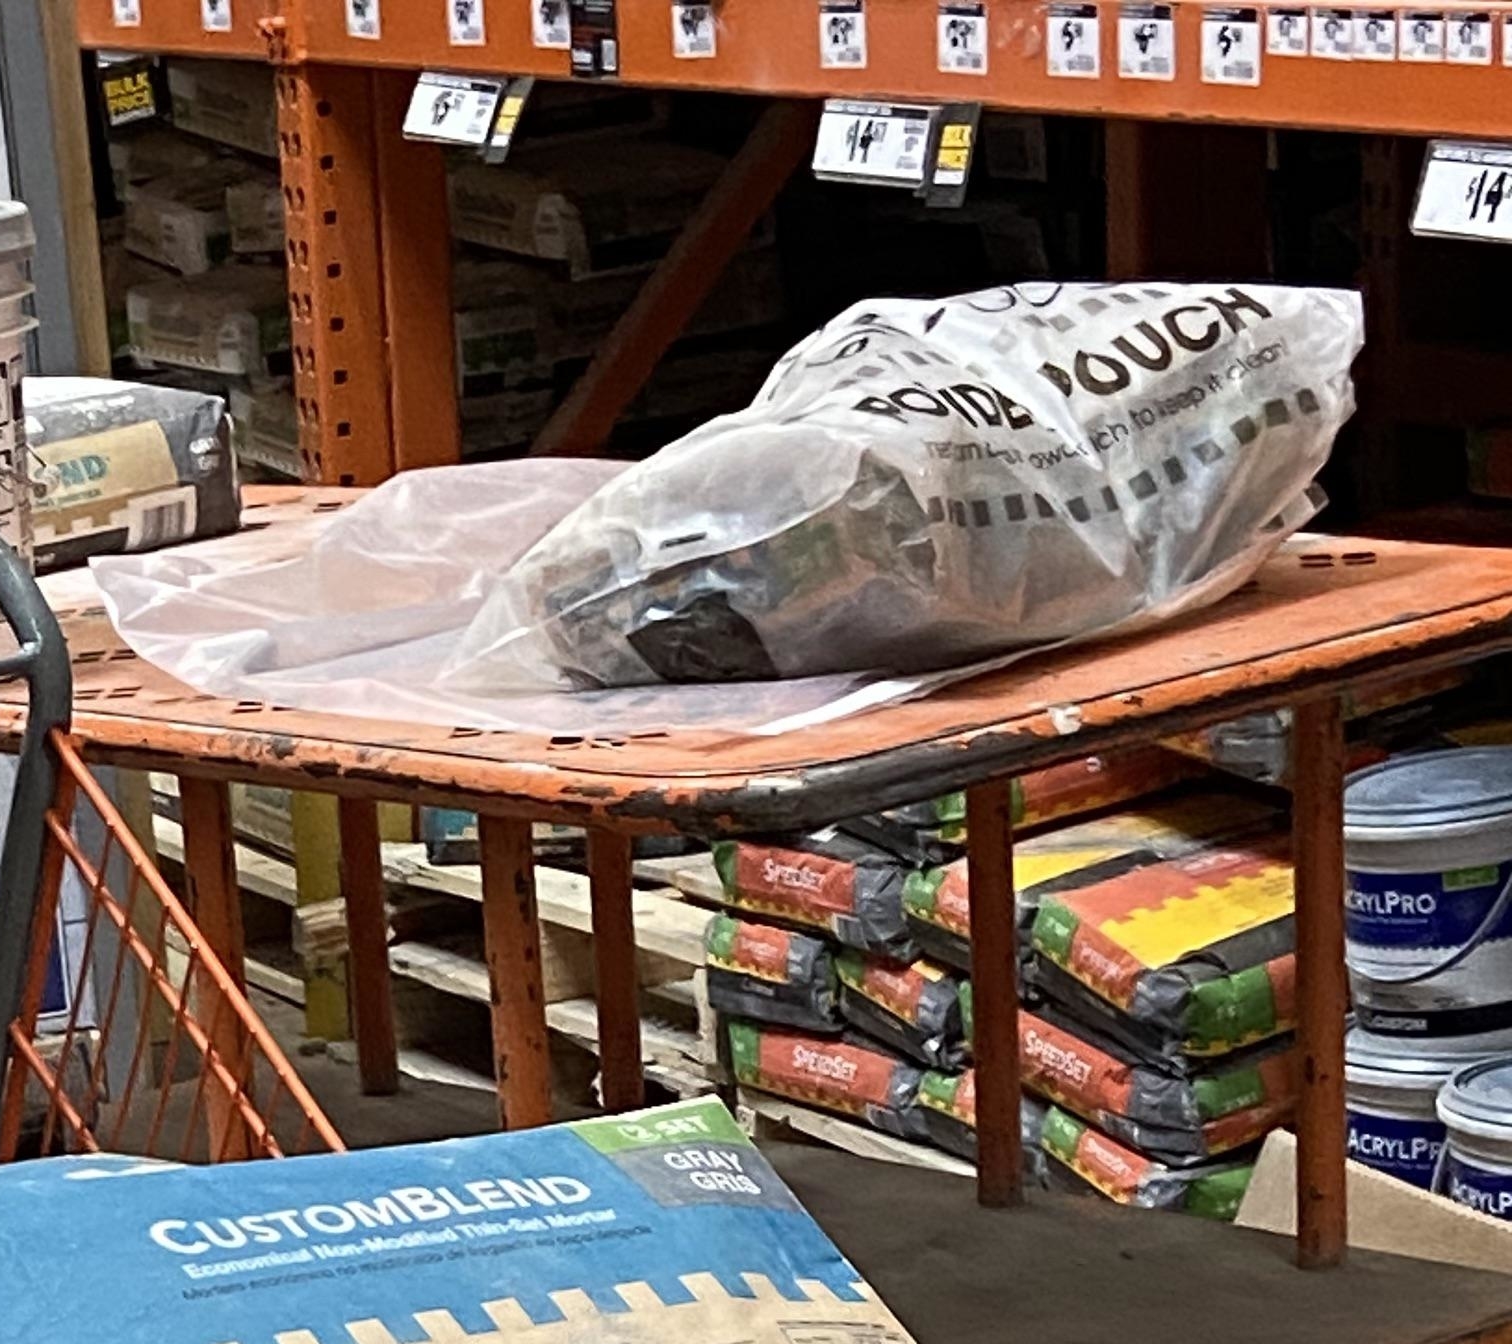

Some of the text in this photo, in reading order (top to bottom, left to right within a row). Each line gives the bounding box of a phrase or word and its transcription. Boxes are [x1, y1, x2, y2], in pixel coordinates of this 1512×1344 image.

[1345, 890, 1438, 916] CRYLPRO
[654, 1115, 712, 1136] SET
[663, 1149, 744, 1173] GRAY
[689, 1170, 762, 1195] GRIS
[148, 1175, 592, 1255] CUSTOMBLEND
